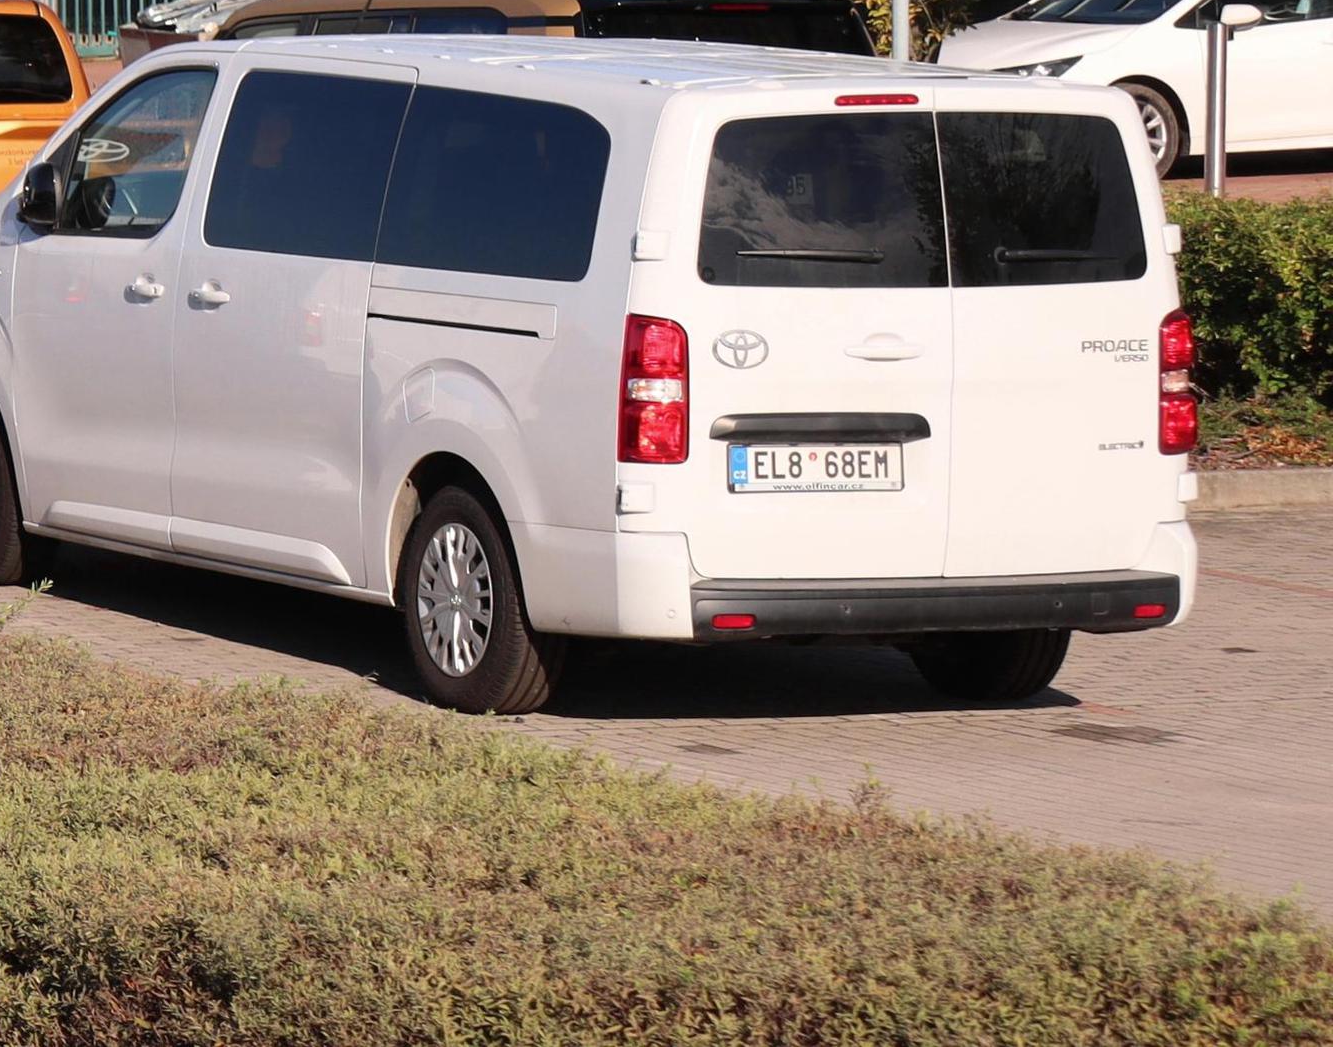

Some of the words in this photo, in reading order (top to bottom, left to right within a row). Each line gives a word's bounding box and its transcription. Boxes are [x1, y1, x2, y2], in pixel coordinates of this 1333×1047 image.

[1081, 339, 1149, 353] PROACE
[1114, 354, 1149, 362] VERSO
[754, 451, 803, 479] EL8
[825, 450, 889, 479] 68EM
[733, 471, 746, 480] CZ
[772, 483, 864, 491] www.olfincar.cz
